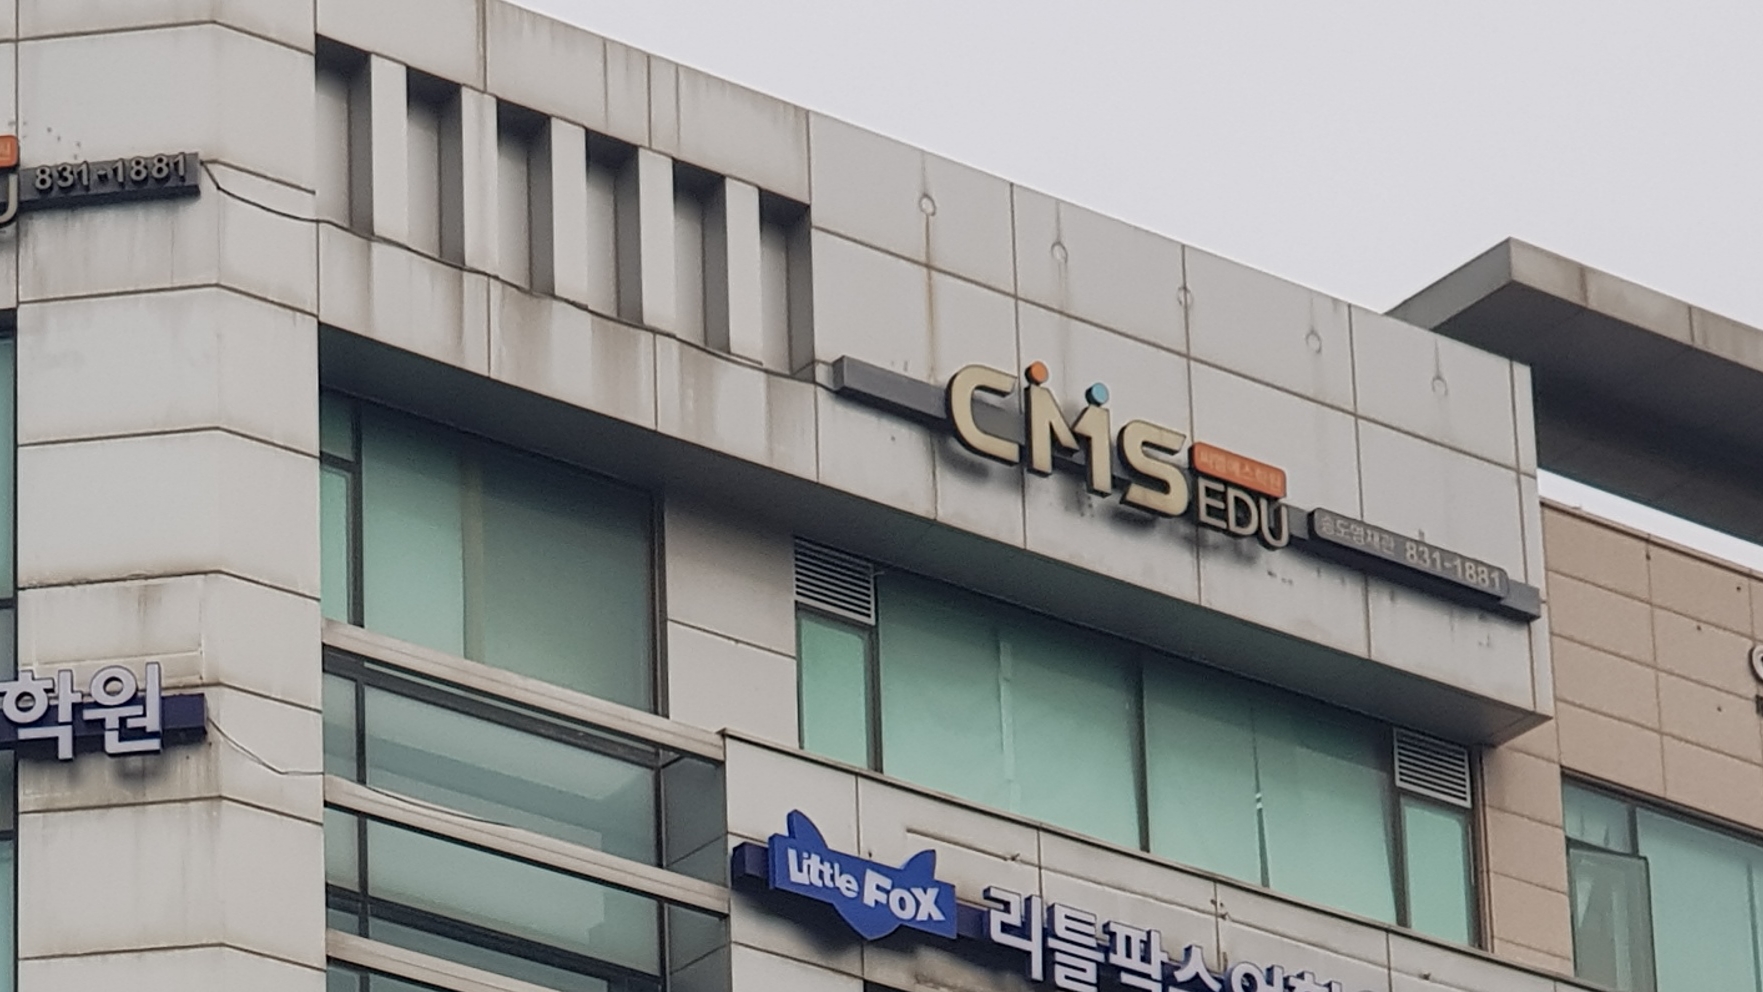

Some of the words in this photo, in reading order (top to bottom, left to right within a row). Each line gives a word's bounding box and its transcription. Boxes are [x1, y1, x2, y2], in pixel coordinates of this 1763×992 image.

[36, 152, 186, 190] 831-1881
[947, 360, 1191, 518] CMS
[1197, 475, 1289, 548] EDU
[1405, 540, 1502, 592] 831-1881
[787, 847, 859, 898] Little
